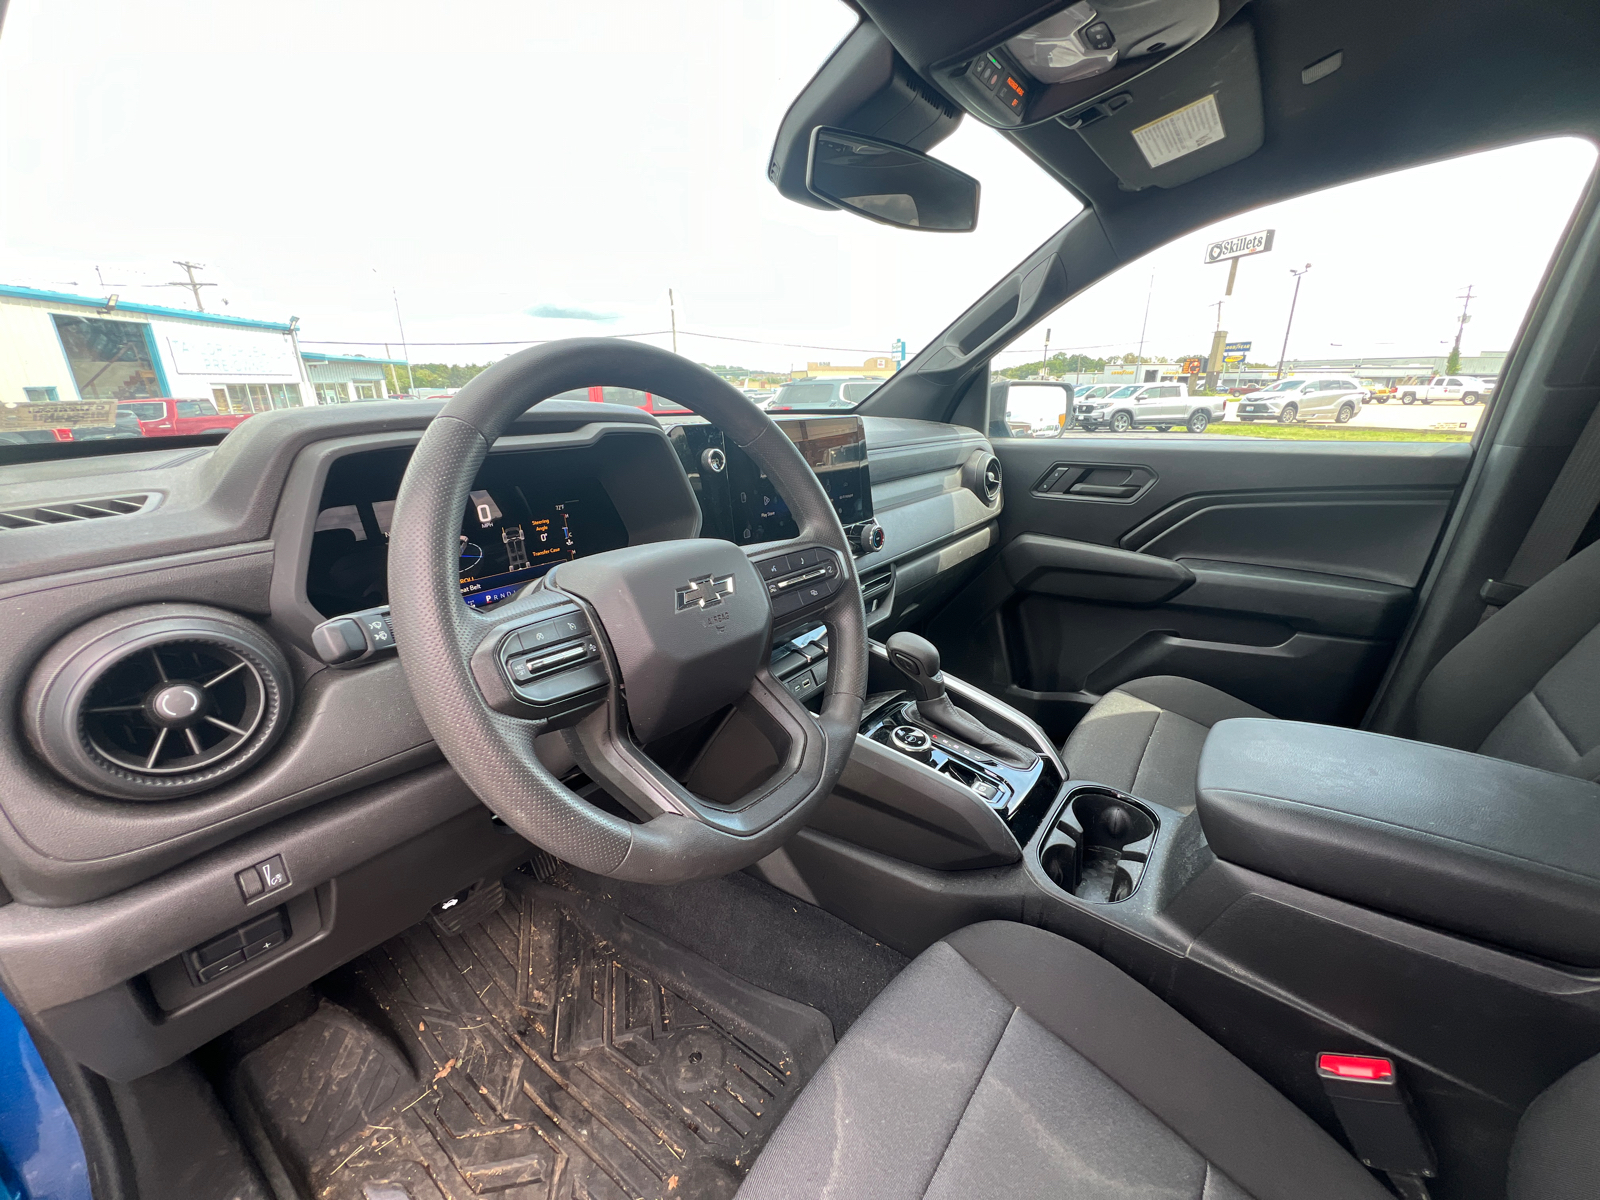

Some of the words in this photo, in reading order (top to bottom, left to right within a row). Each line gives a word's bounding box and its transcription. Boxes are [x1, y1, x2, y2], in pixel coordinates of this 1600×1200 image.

[1222, 236, 1263, 255] Skillets
[477, 504, 492, 521] 0
[470, 583, 481, 591] Belt
